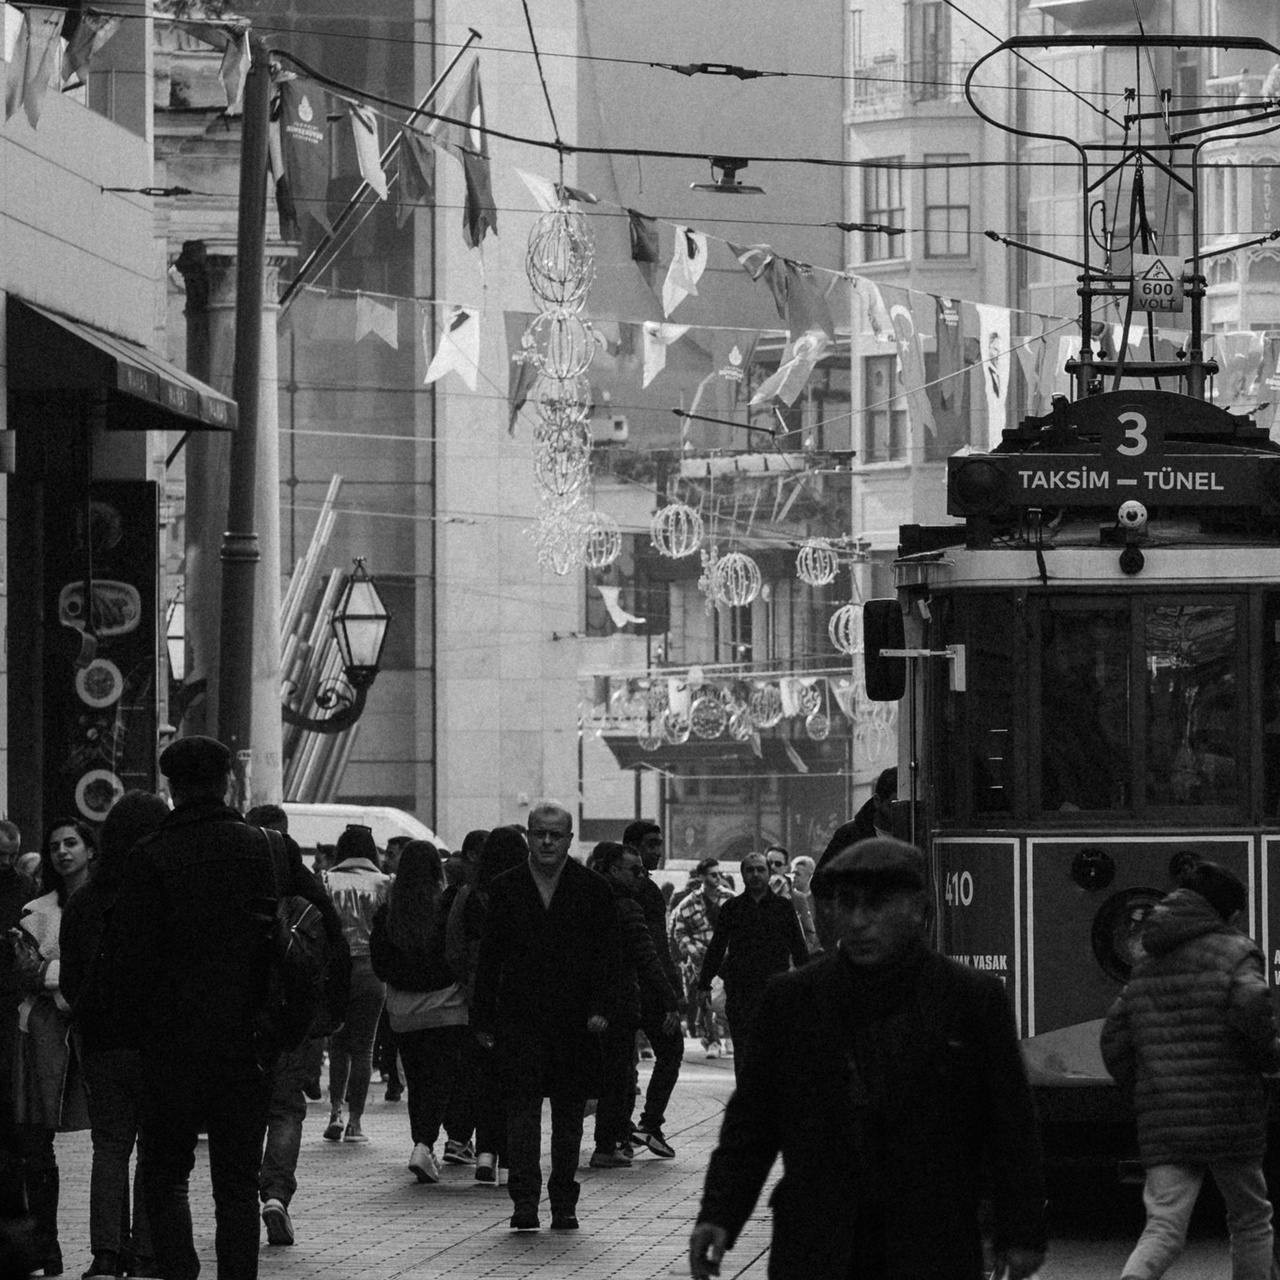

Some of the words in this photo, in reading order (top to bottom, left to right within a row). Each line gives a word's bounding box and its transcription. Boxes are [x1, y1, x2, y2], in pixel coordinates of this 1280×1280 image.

[1142, 283, 1174, 296] 600
[1139, 297, 1176, 310] VOLT
[1116, 411, 1148, 456] 3
[1018, 465, 1109, 489] TAKSİM
[1143, 466, 1225, 491] TÜNEL
[945, 870, 974, 906] 410
[973, 955, 1008, 970] YASAK
